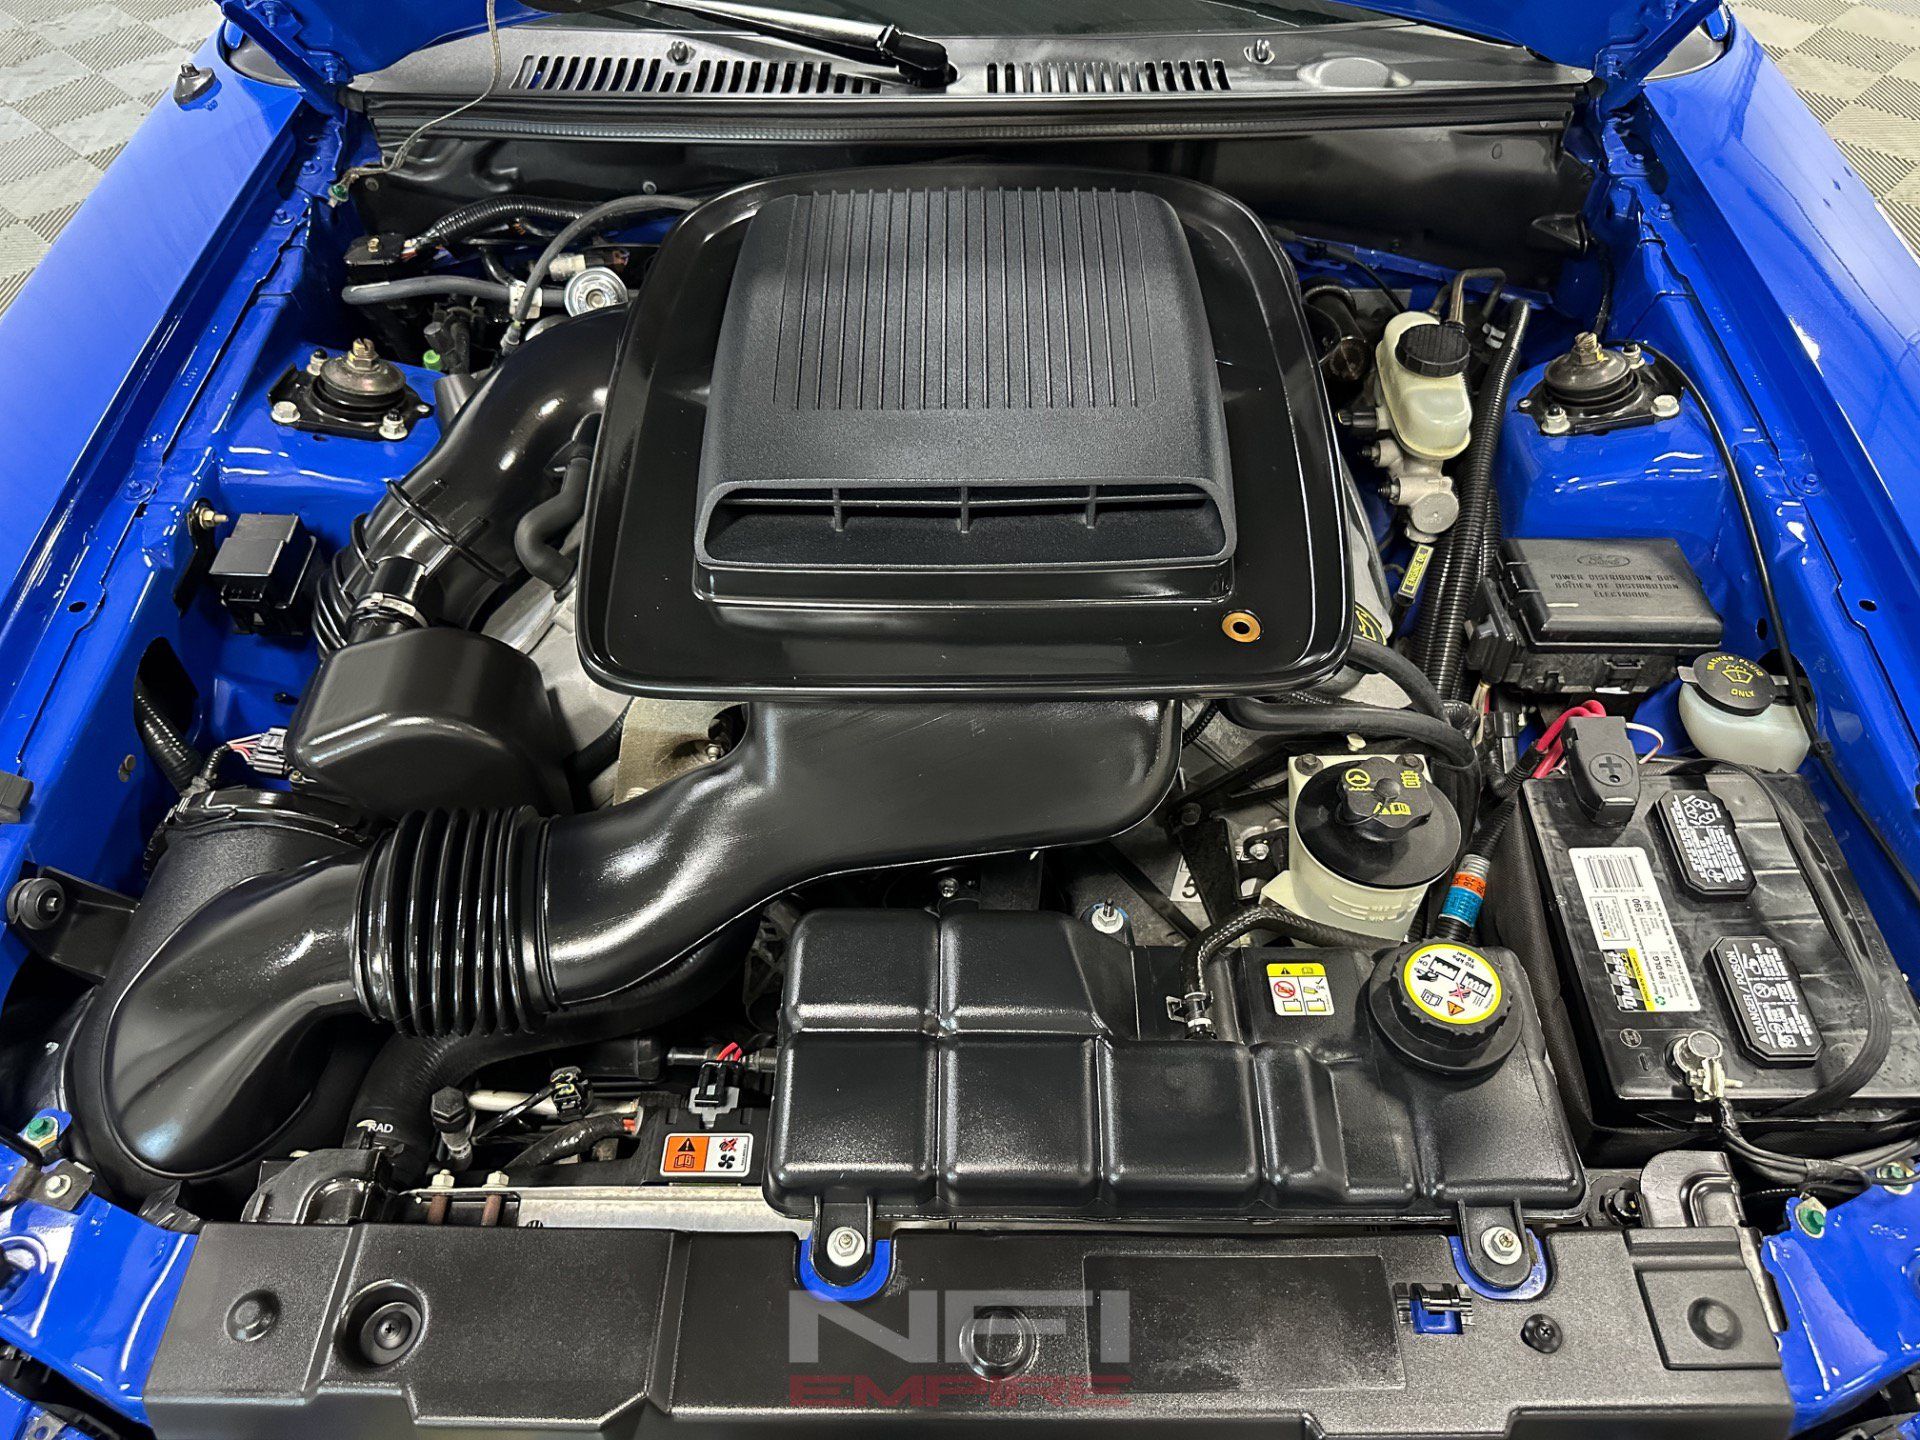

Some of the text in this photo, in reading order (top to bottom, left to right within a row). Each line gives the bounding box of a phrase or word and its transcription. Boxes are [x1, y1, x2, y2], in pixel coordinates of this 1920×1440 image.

[1406, 562, 1422, 585] ENGINE
[1550, 573, 1584, 581] POWER
[1615, 582, 1679, 590] DISTRIBUTION
[1707, 655, 1764, 677] WASHER FLUID
[1731, 688, 1755, 698] ONLY
[1631, 898, 1644, 913] 590
[1417, 958, 1429, 967] OK
[1726, 950, 1748, 986] POISON
[1608, 951, 1638, 1009] Duralast
[1742, 994, 1767, 1034] DANGER
